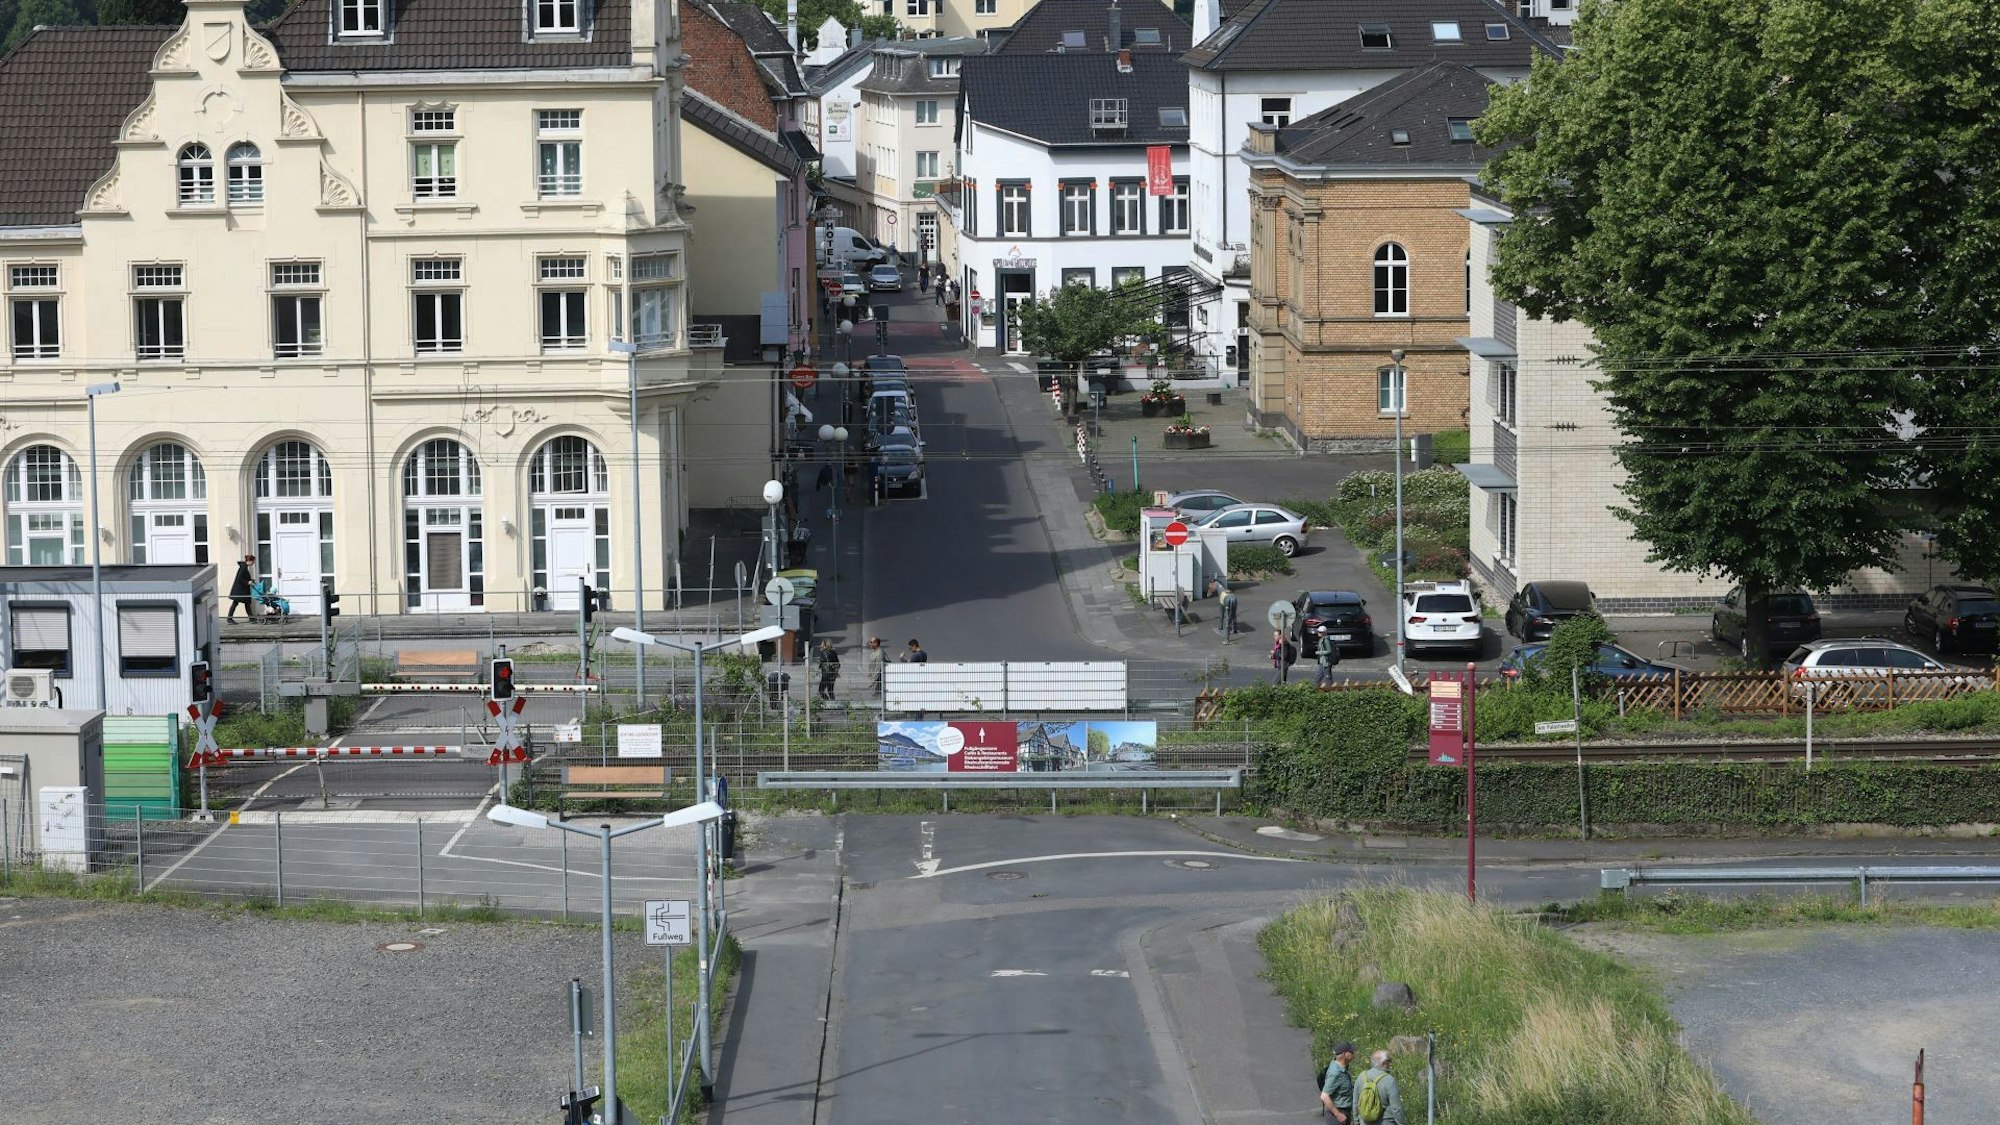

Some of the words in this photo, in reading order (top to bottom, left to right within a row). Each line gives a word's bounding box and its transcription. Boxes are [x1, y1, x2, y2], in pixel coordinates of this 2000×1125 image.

[826, 222, 834, 265] HOTEL
[1157, 494, 1166, 504] T
[653, 933, 683, 941] Fußweg
